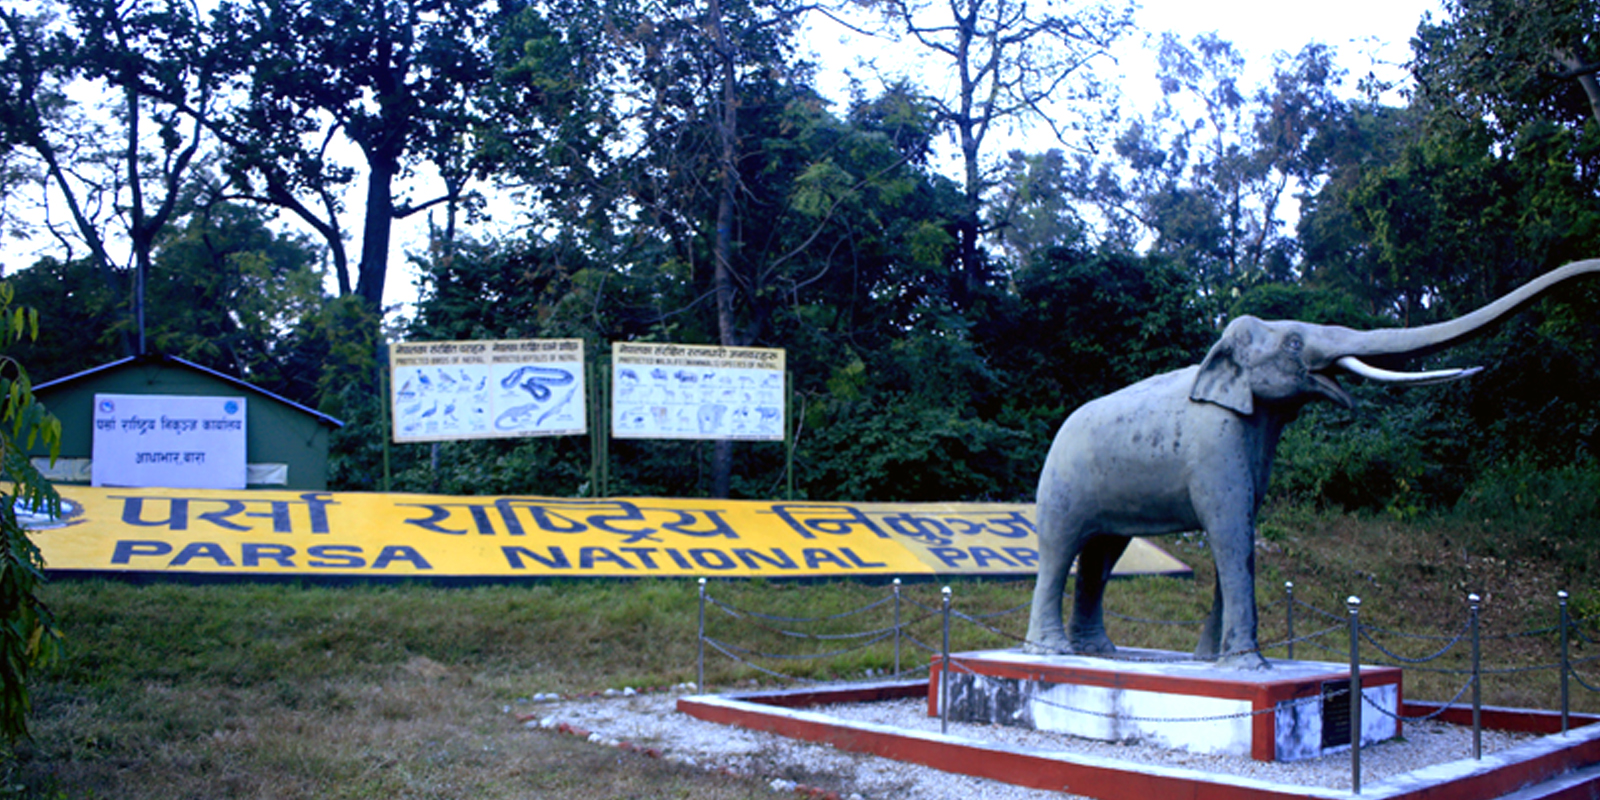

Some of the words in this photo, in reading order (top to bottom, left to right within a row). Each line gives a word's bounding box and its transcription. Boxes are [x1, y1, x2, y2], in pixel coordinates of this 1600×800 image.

[396, 357, 429, 365] PROTECTED
[432, 356, 449, 365] BIRDS
[452, 356, 460, 364] OF
[550, 354, 556, 362] OF
[618, 356, 654, 365] PROTECTED
[747, 361, 755, 369] OF
[96, 414, 116, 431] पर्सा
[108, 492, 340, 534] पर्सा
[394, 497, 741, 543] राष्ट्रिय
[110, 540, 433, 569] PARSA
[500, 545, 887, 571] NATIONAL
[926, 546, 1040, 568] PAR
